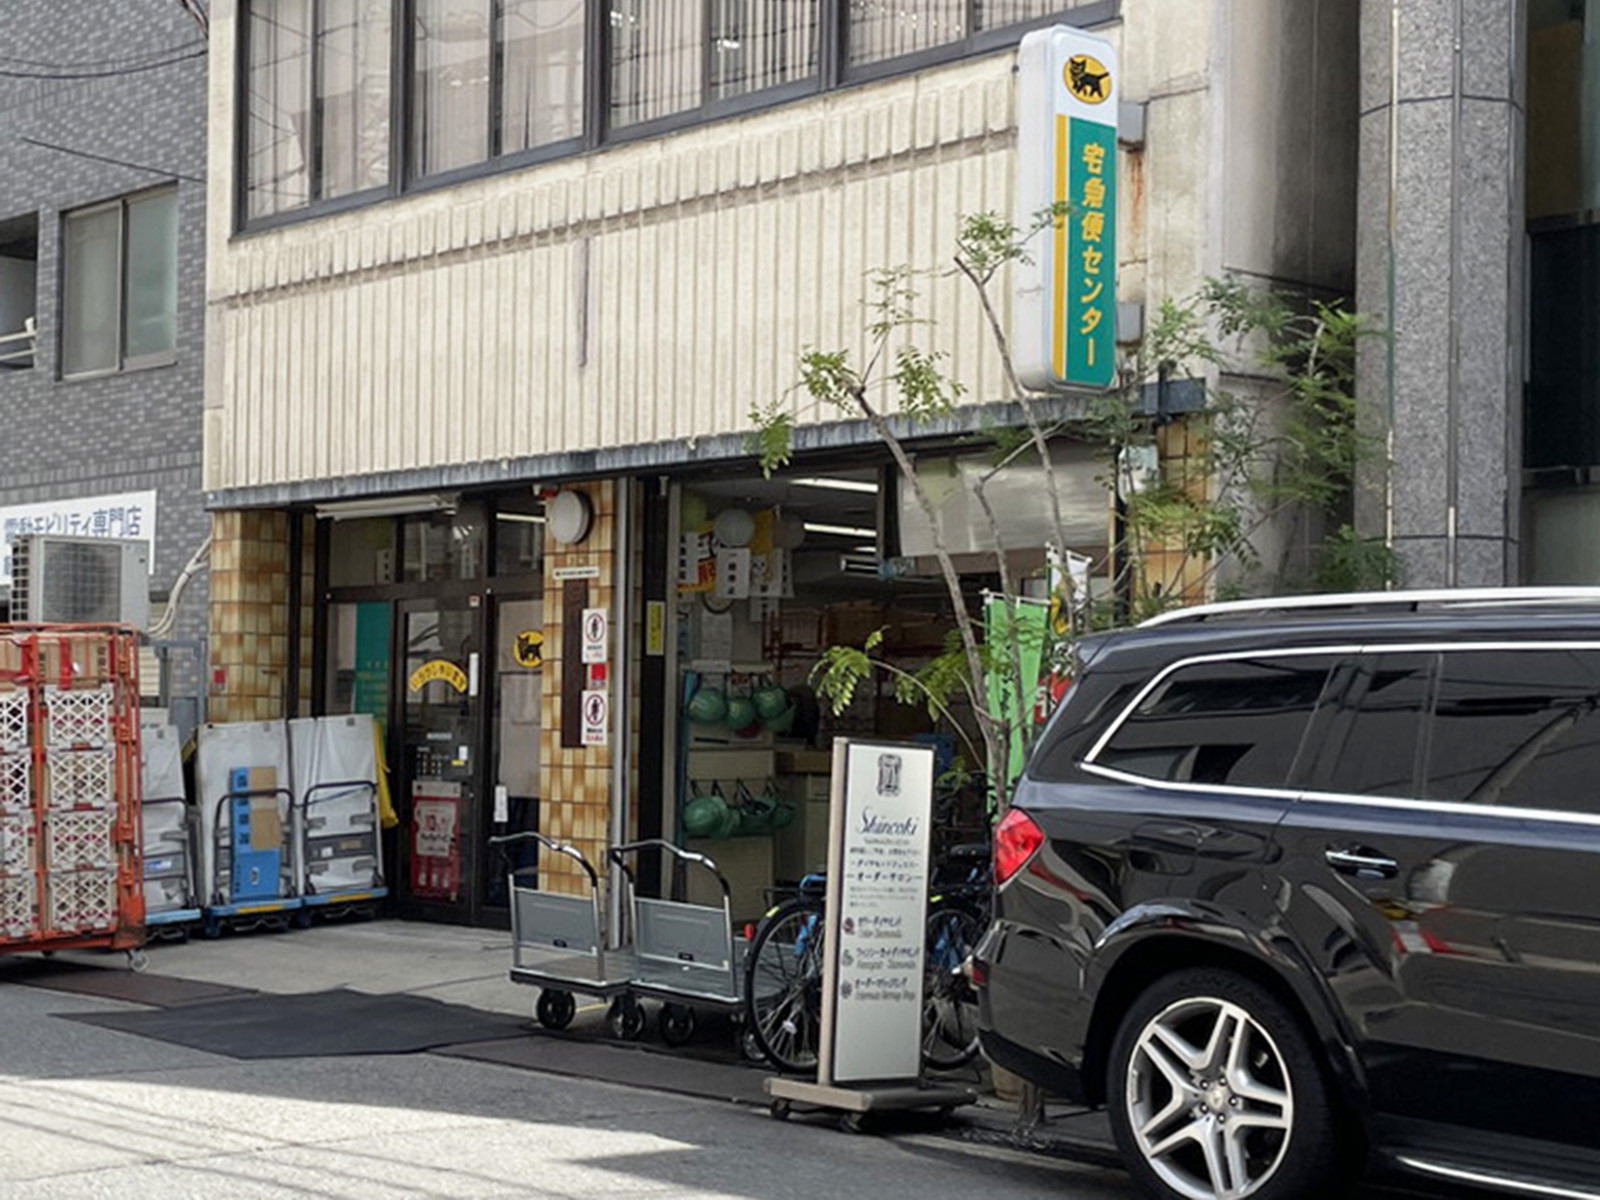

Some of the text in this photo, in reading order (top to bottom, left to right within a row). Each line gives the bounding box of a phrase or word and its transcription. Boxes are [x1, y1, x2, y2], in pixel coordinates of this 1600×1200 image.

[1081, 142, 1106, 367] 宅急便センター
